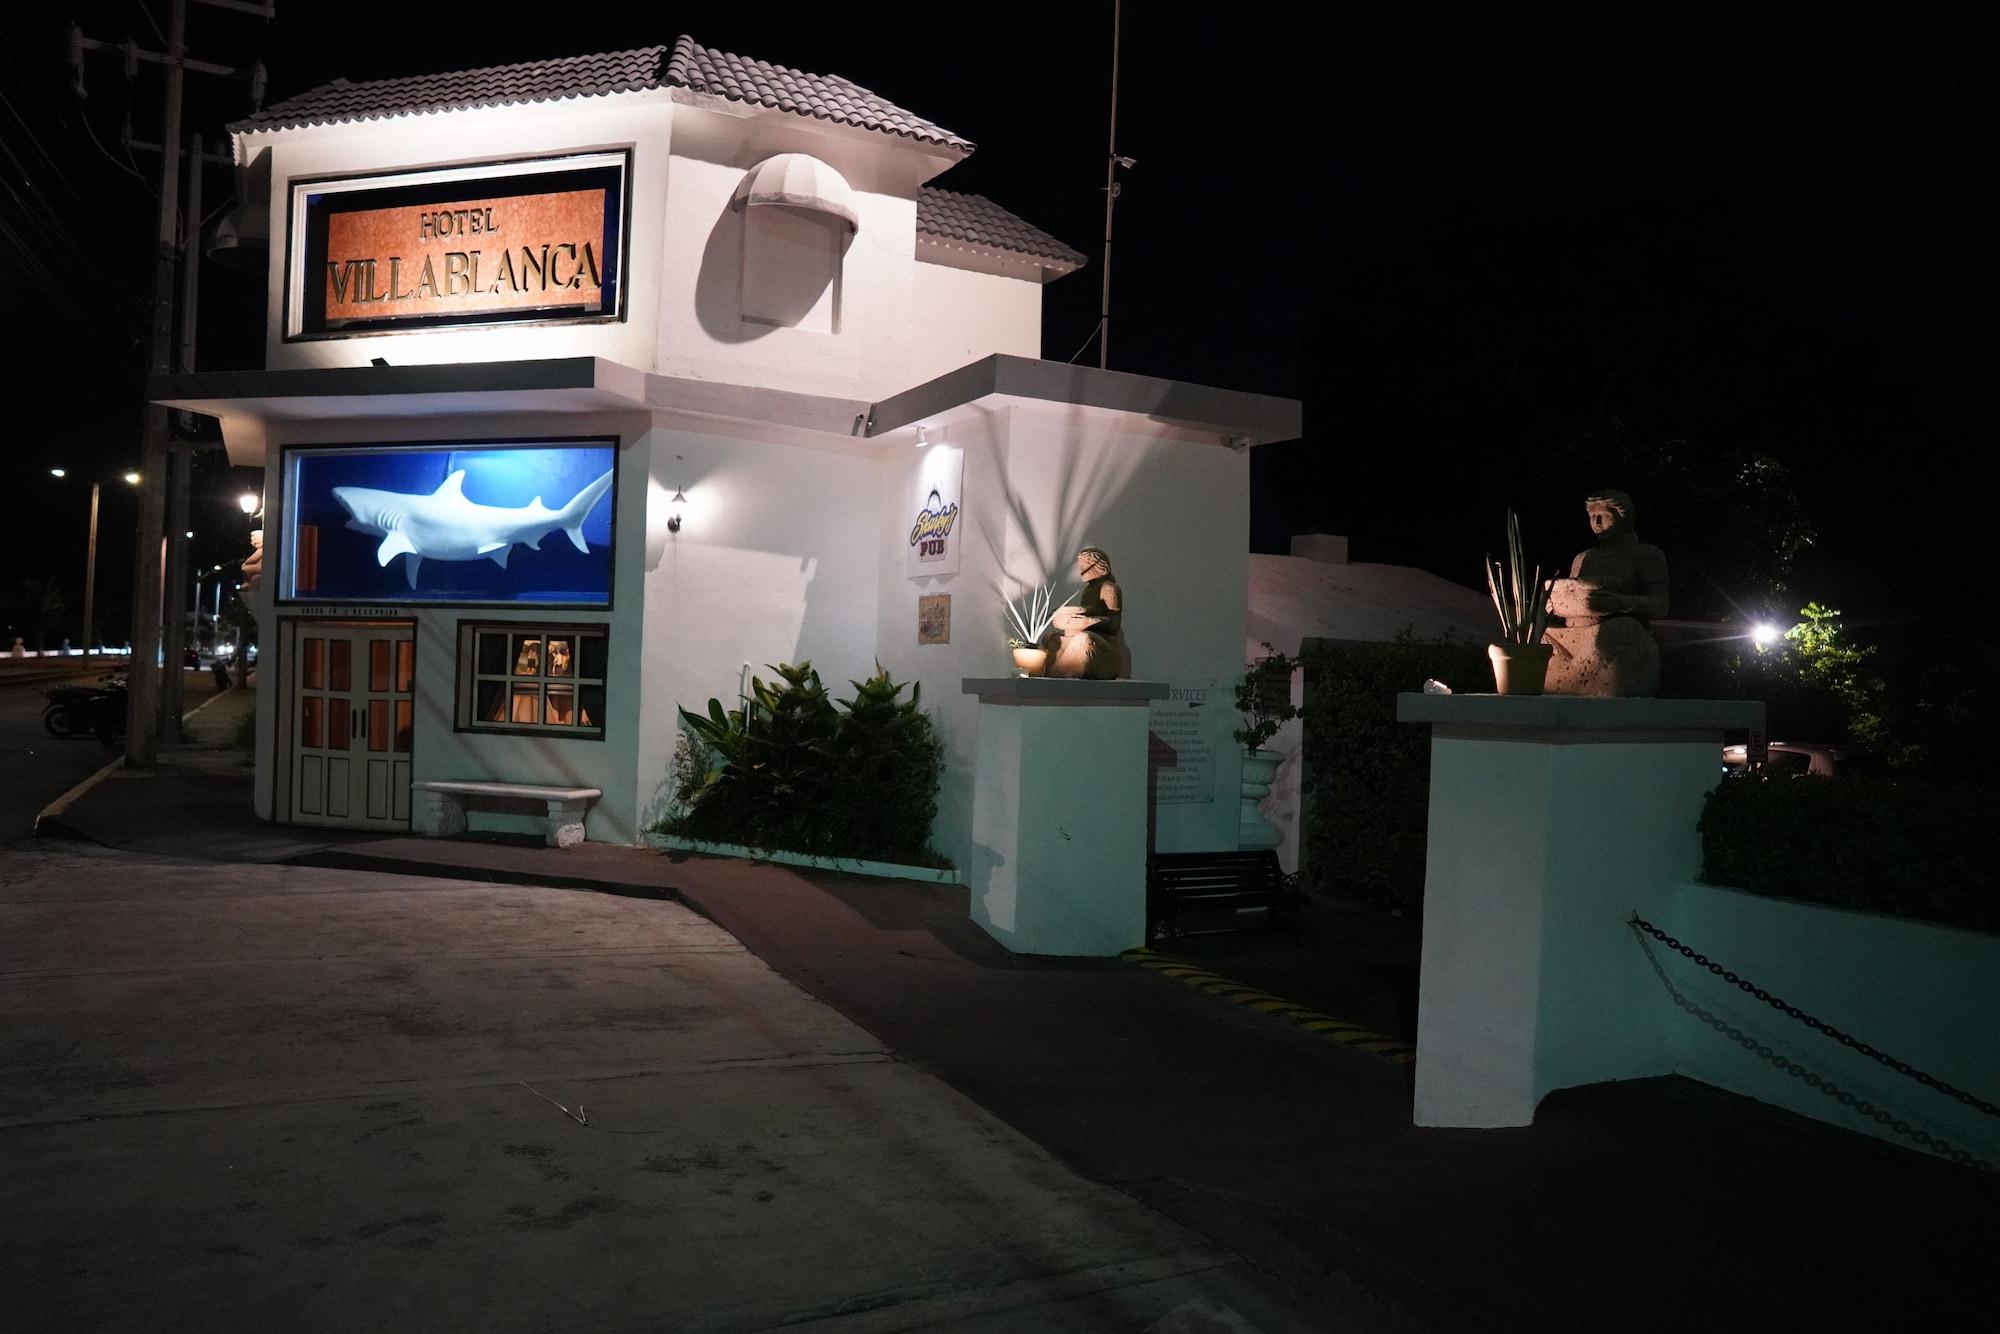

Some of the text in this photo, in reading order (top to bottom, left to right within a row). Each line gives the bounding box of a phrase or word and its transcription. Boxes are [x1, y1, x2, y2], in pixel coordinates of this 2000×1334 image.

[419, 207, 499, 240] HOTEL
[327, 241, 602, 305] VILLABLANCA
[920, 540, 944, 556] PUB
